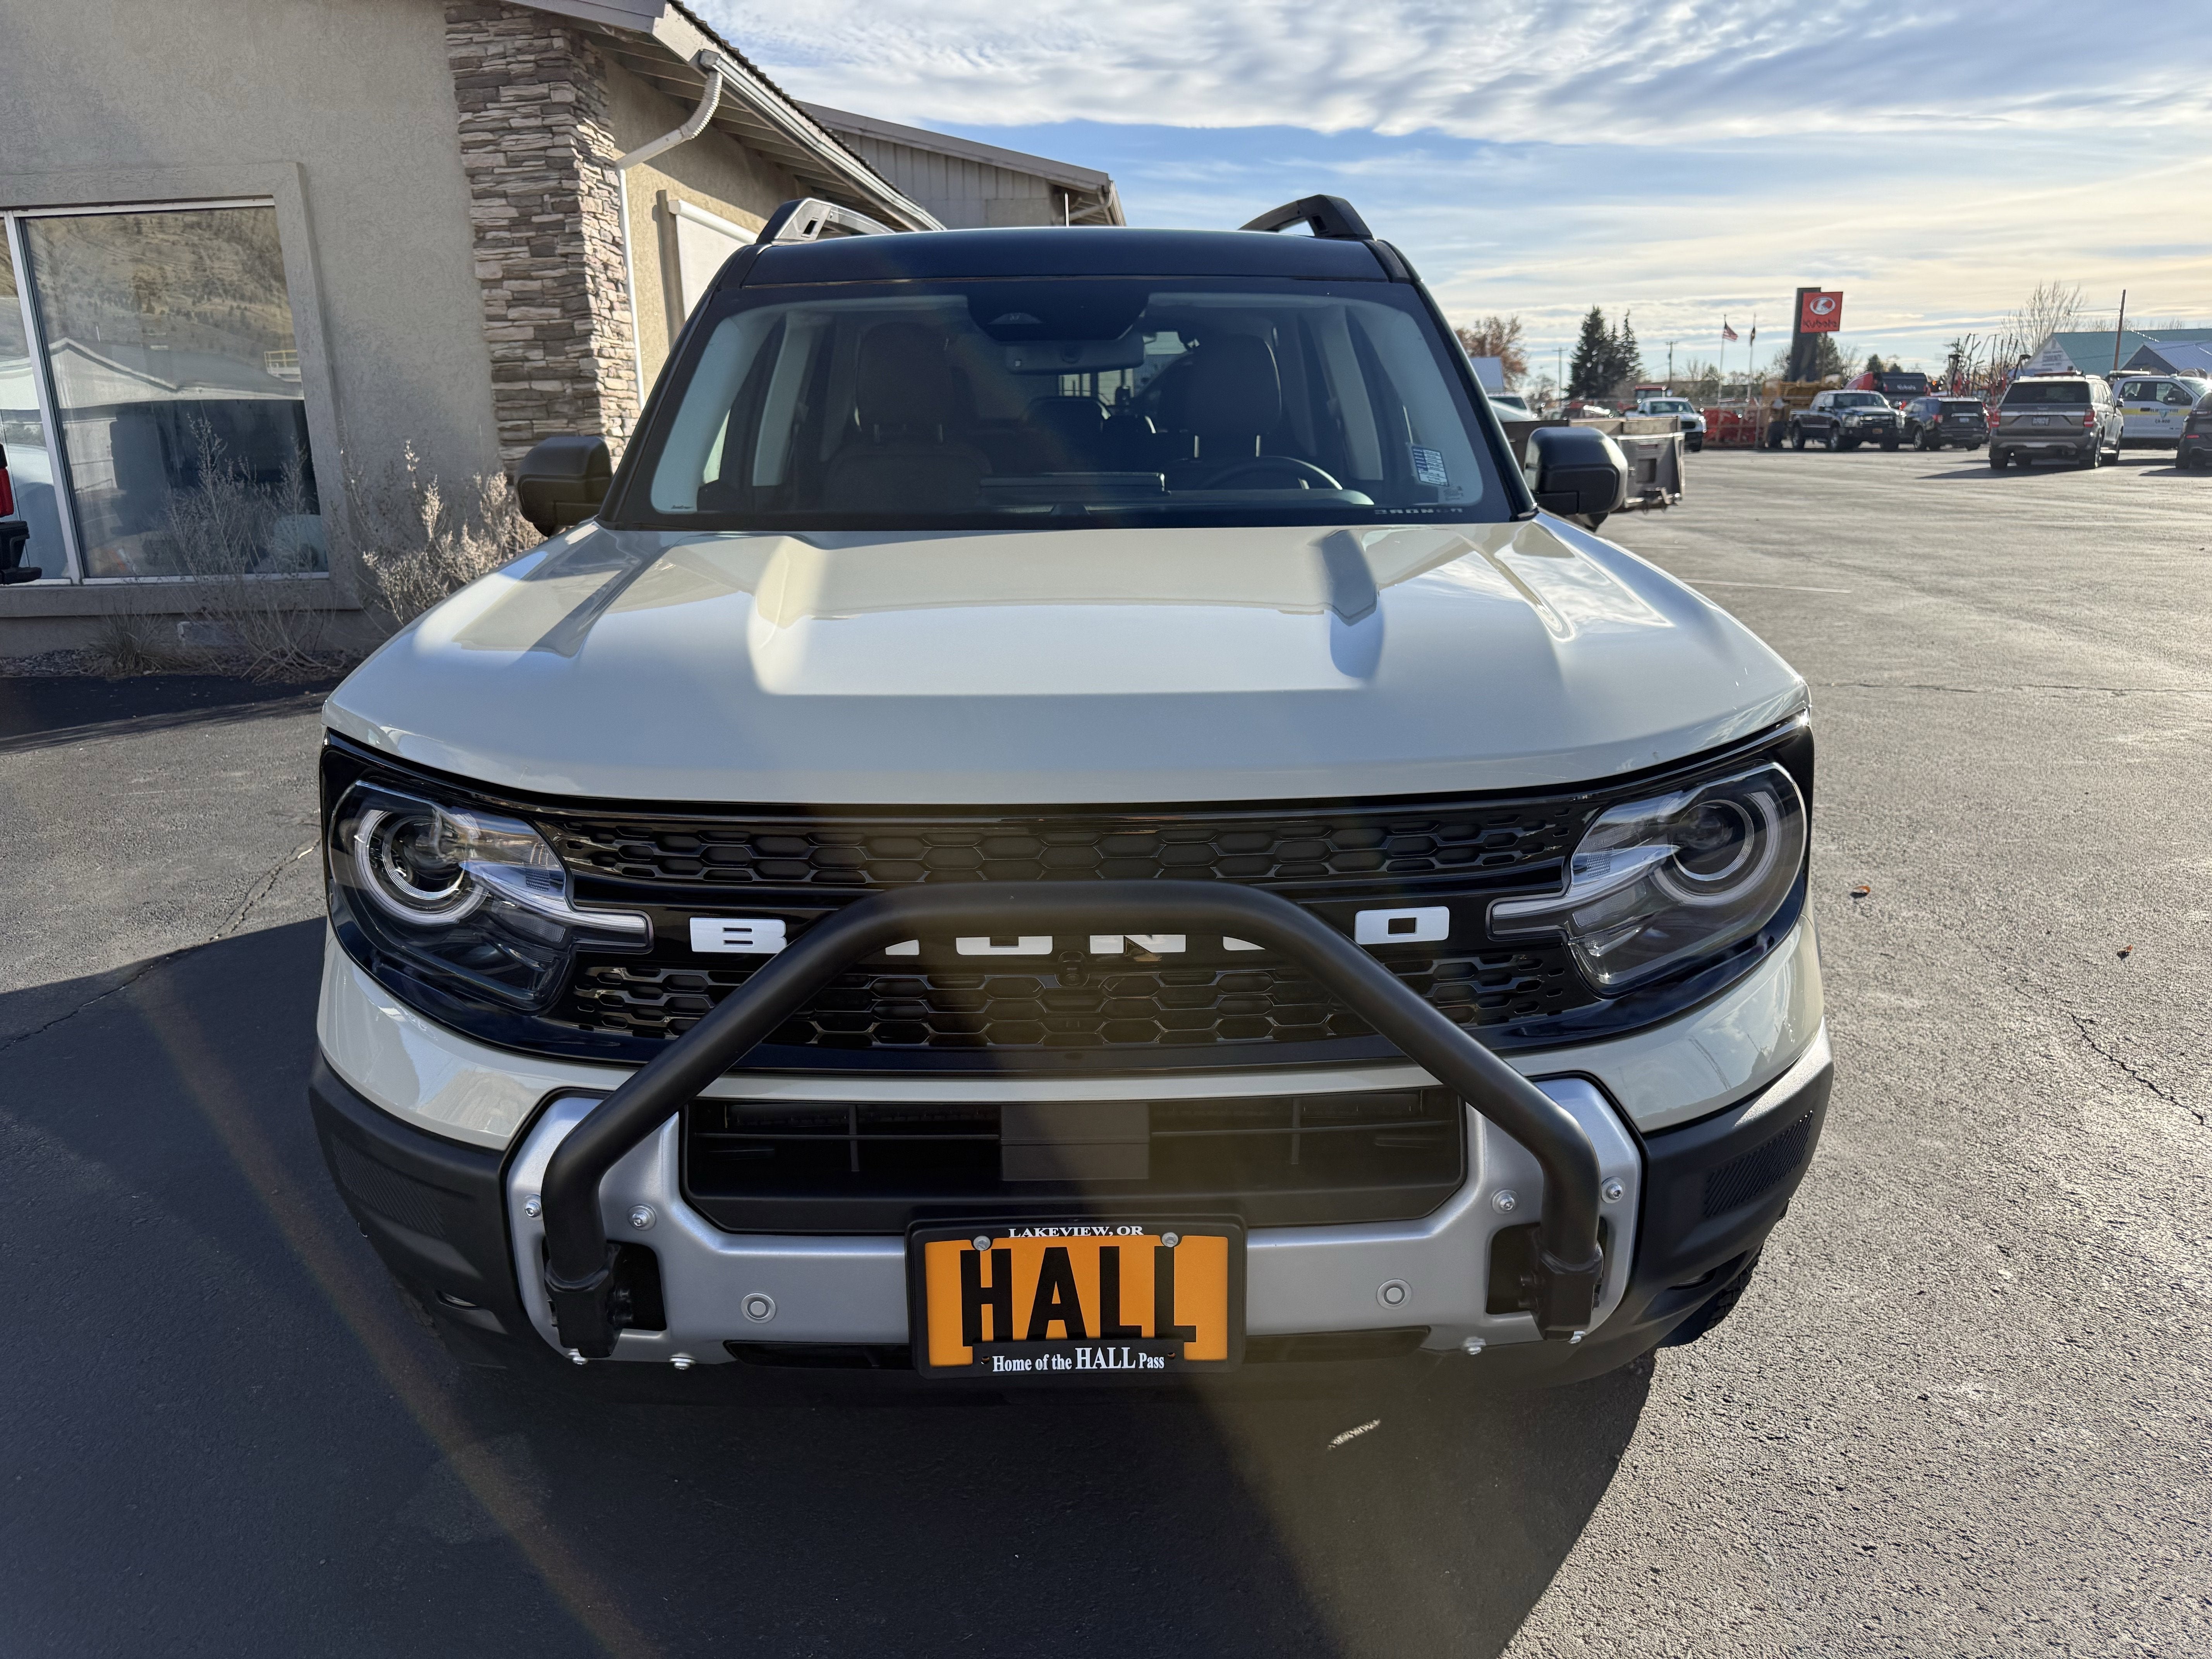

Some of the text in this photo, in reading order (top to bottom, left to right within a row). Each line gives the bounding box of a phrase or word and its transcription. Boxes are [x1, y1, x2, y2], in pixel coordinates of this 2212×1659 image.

[1803, 319, 1837, 328] Kubota
[1008, 1226, 1144, 1238] LAKEVIEW, OR
[960, 1245, 1197, 1346] HALL
[993, 1347, 1165, 1372] Home of the HALL Pass
